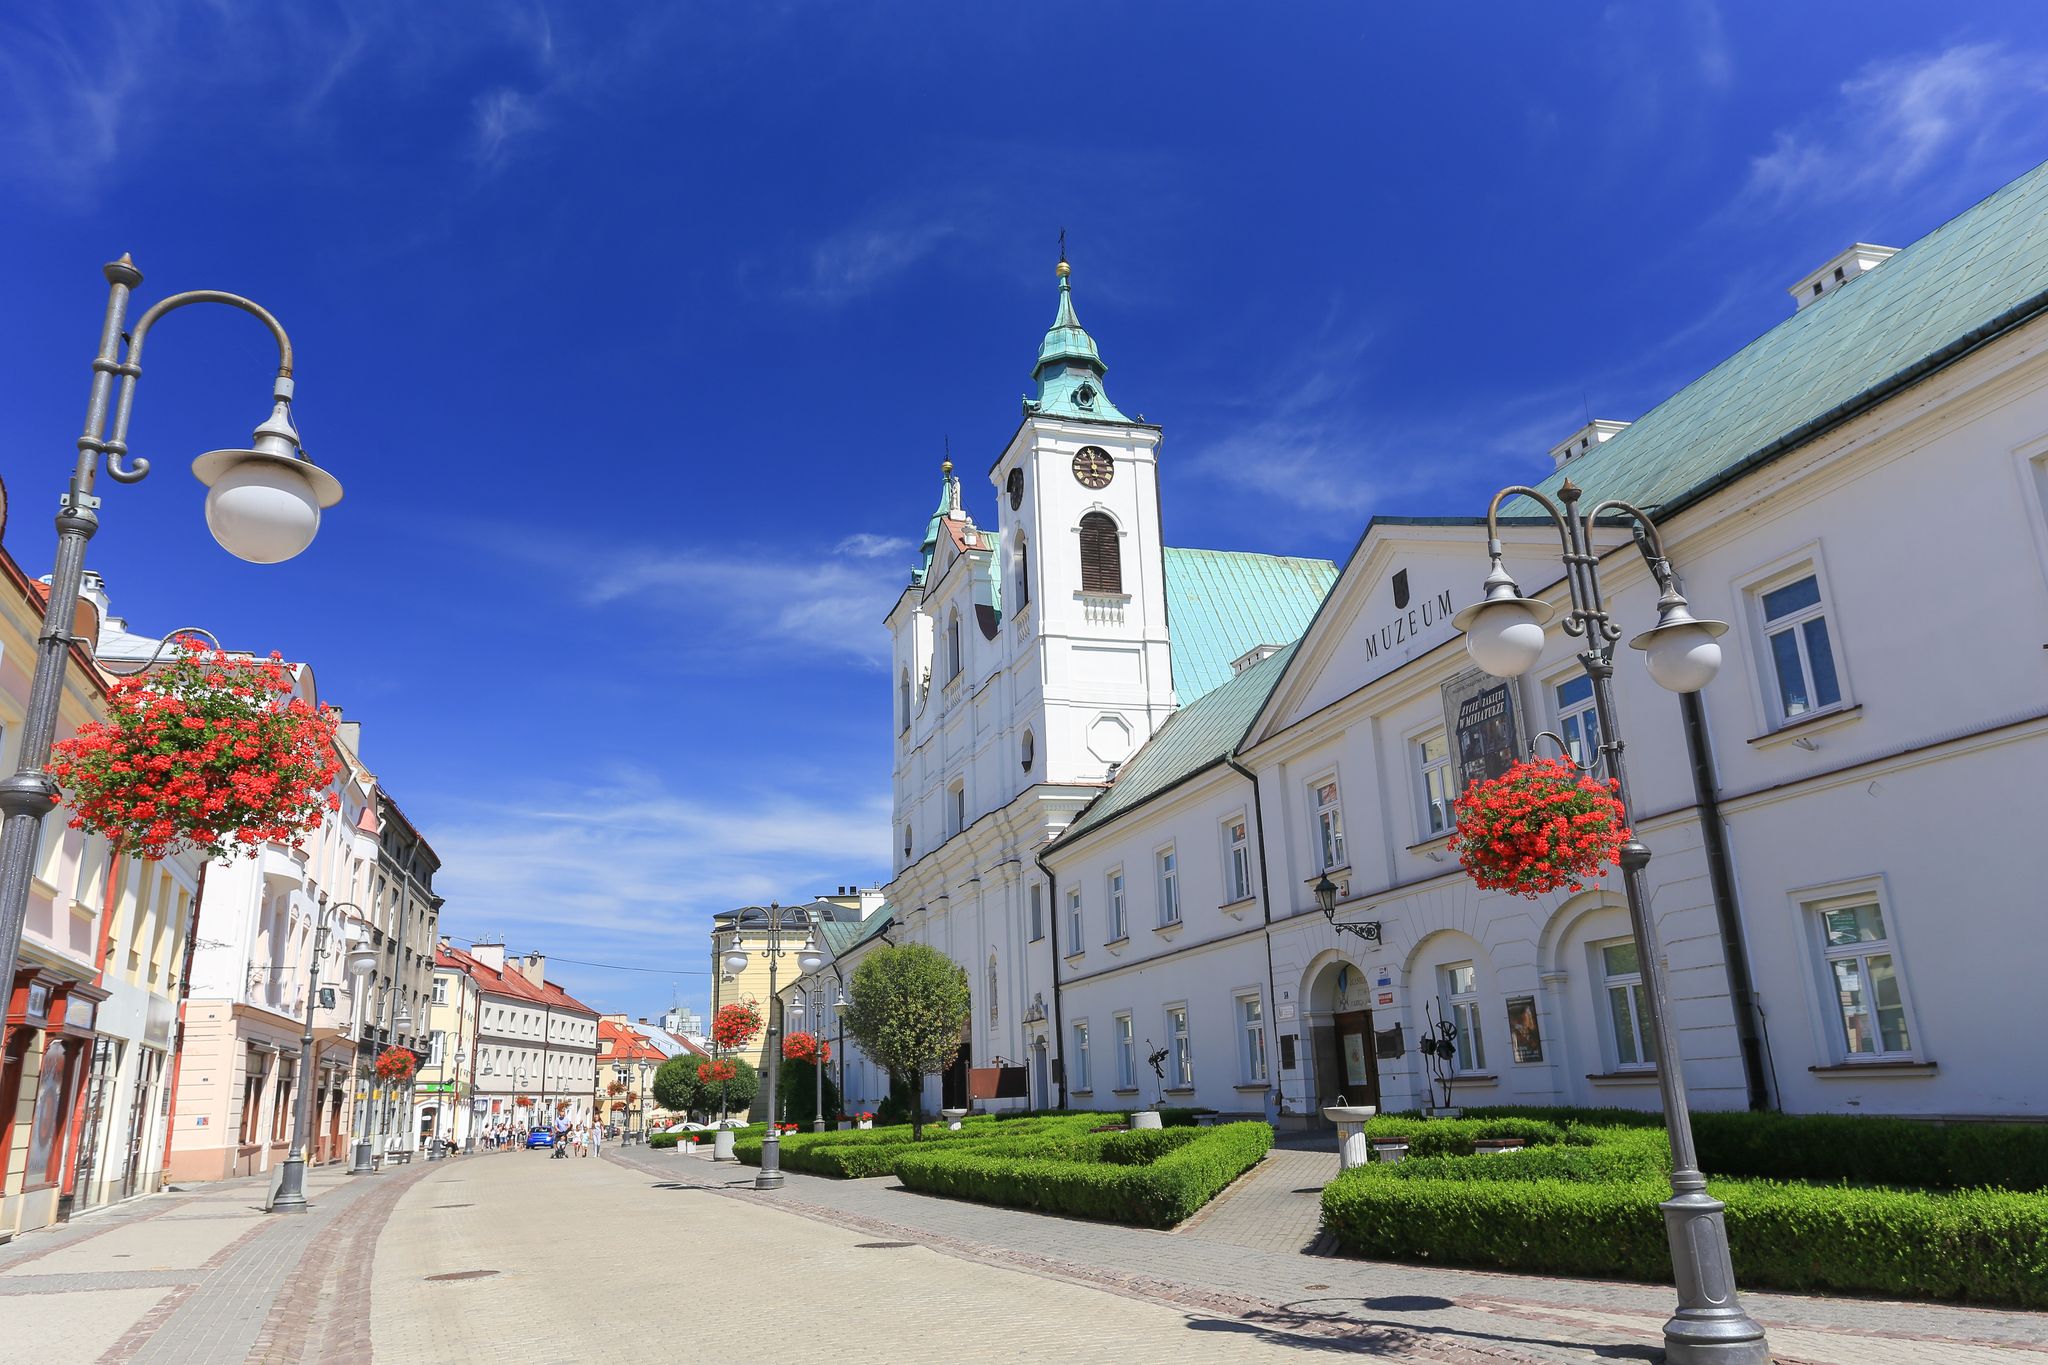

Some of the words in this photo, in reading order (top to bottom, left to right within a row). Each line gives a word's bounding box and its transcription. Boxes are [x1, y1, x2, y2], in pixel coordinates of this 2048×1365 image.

[1365, 589, 1453, 662] MUZEUM
[1459, 717, 1466, 729] W
[1465, 701, 1505, 727] MINIATURZE
